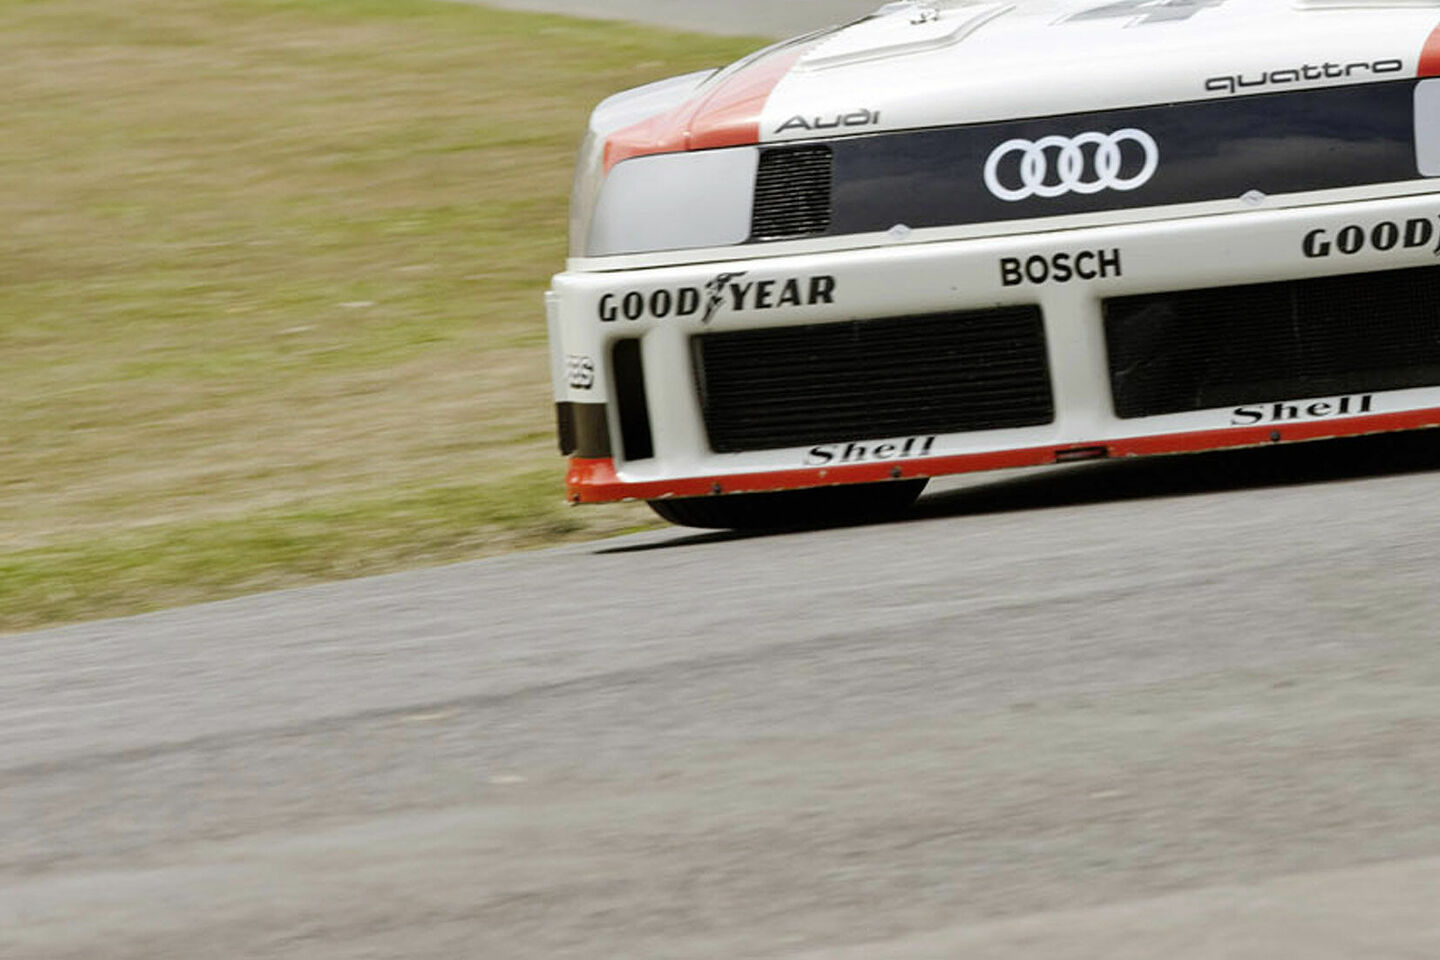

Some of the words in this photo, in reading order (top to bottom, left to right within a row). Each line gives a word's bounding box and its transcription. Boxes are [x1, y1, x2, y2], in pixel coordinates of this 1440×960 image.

[1204, 57, 1403, 94] quattro
[774, 107, 881, 134] Audi
[1000, 248, 1123, 287] BOSCH
[1231, 395, 1372, 426] Shell
[804, 436, 935, 465] Shell
